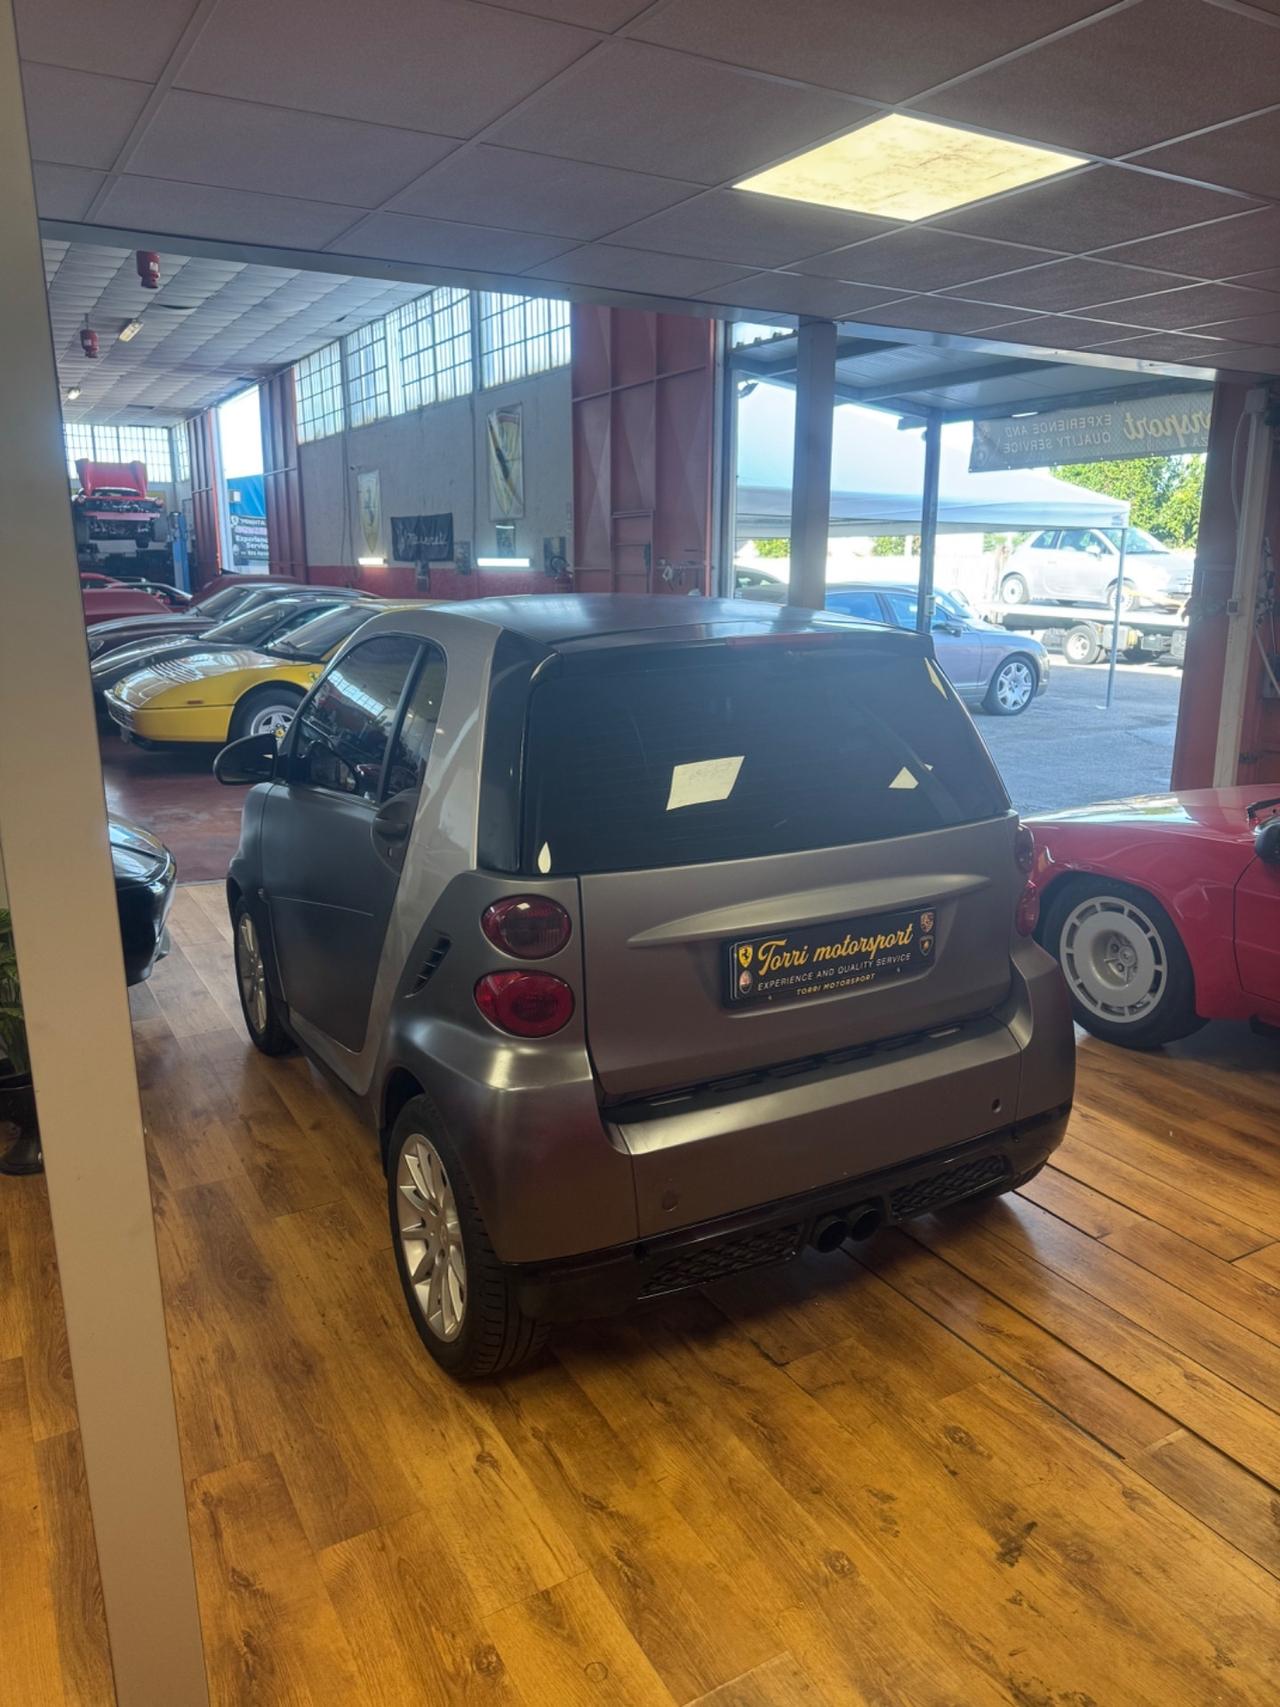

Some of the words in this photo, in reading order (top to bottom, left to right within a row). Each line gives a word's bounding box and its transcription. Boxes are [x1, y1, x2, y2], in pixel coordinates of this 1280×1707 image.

[757, 938, 808, 976] Torri
[813, 923, 914, 962] motorsport
[757, 972, 815, 992] EXPERIENCE
[816, 967, 835, 979] AND
[837, 960, 874, 976] QUALITY
[875, 952, 912, 967] SERVICE
[796, 985, 821, 996] TORRI
[822, 973, 877, 991] MOTORSPORT
